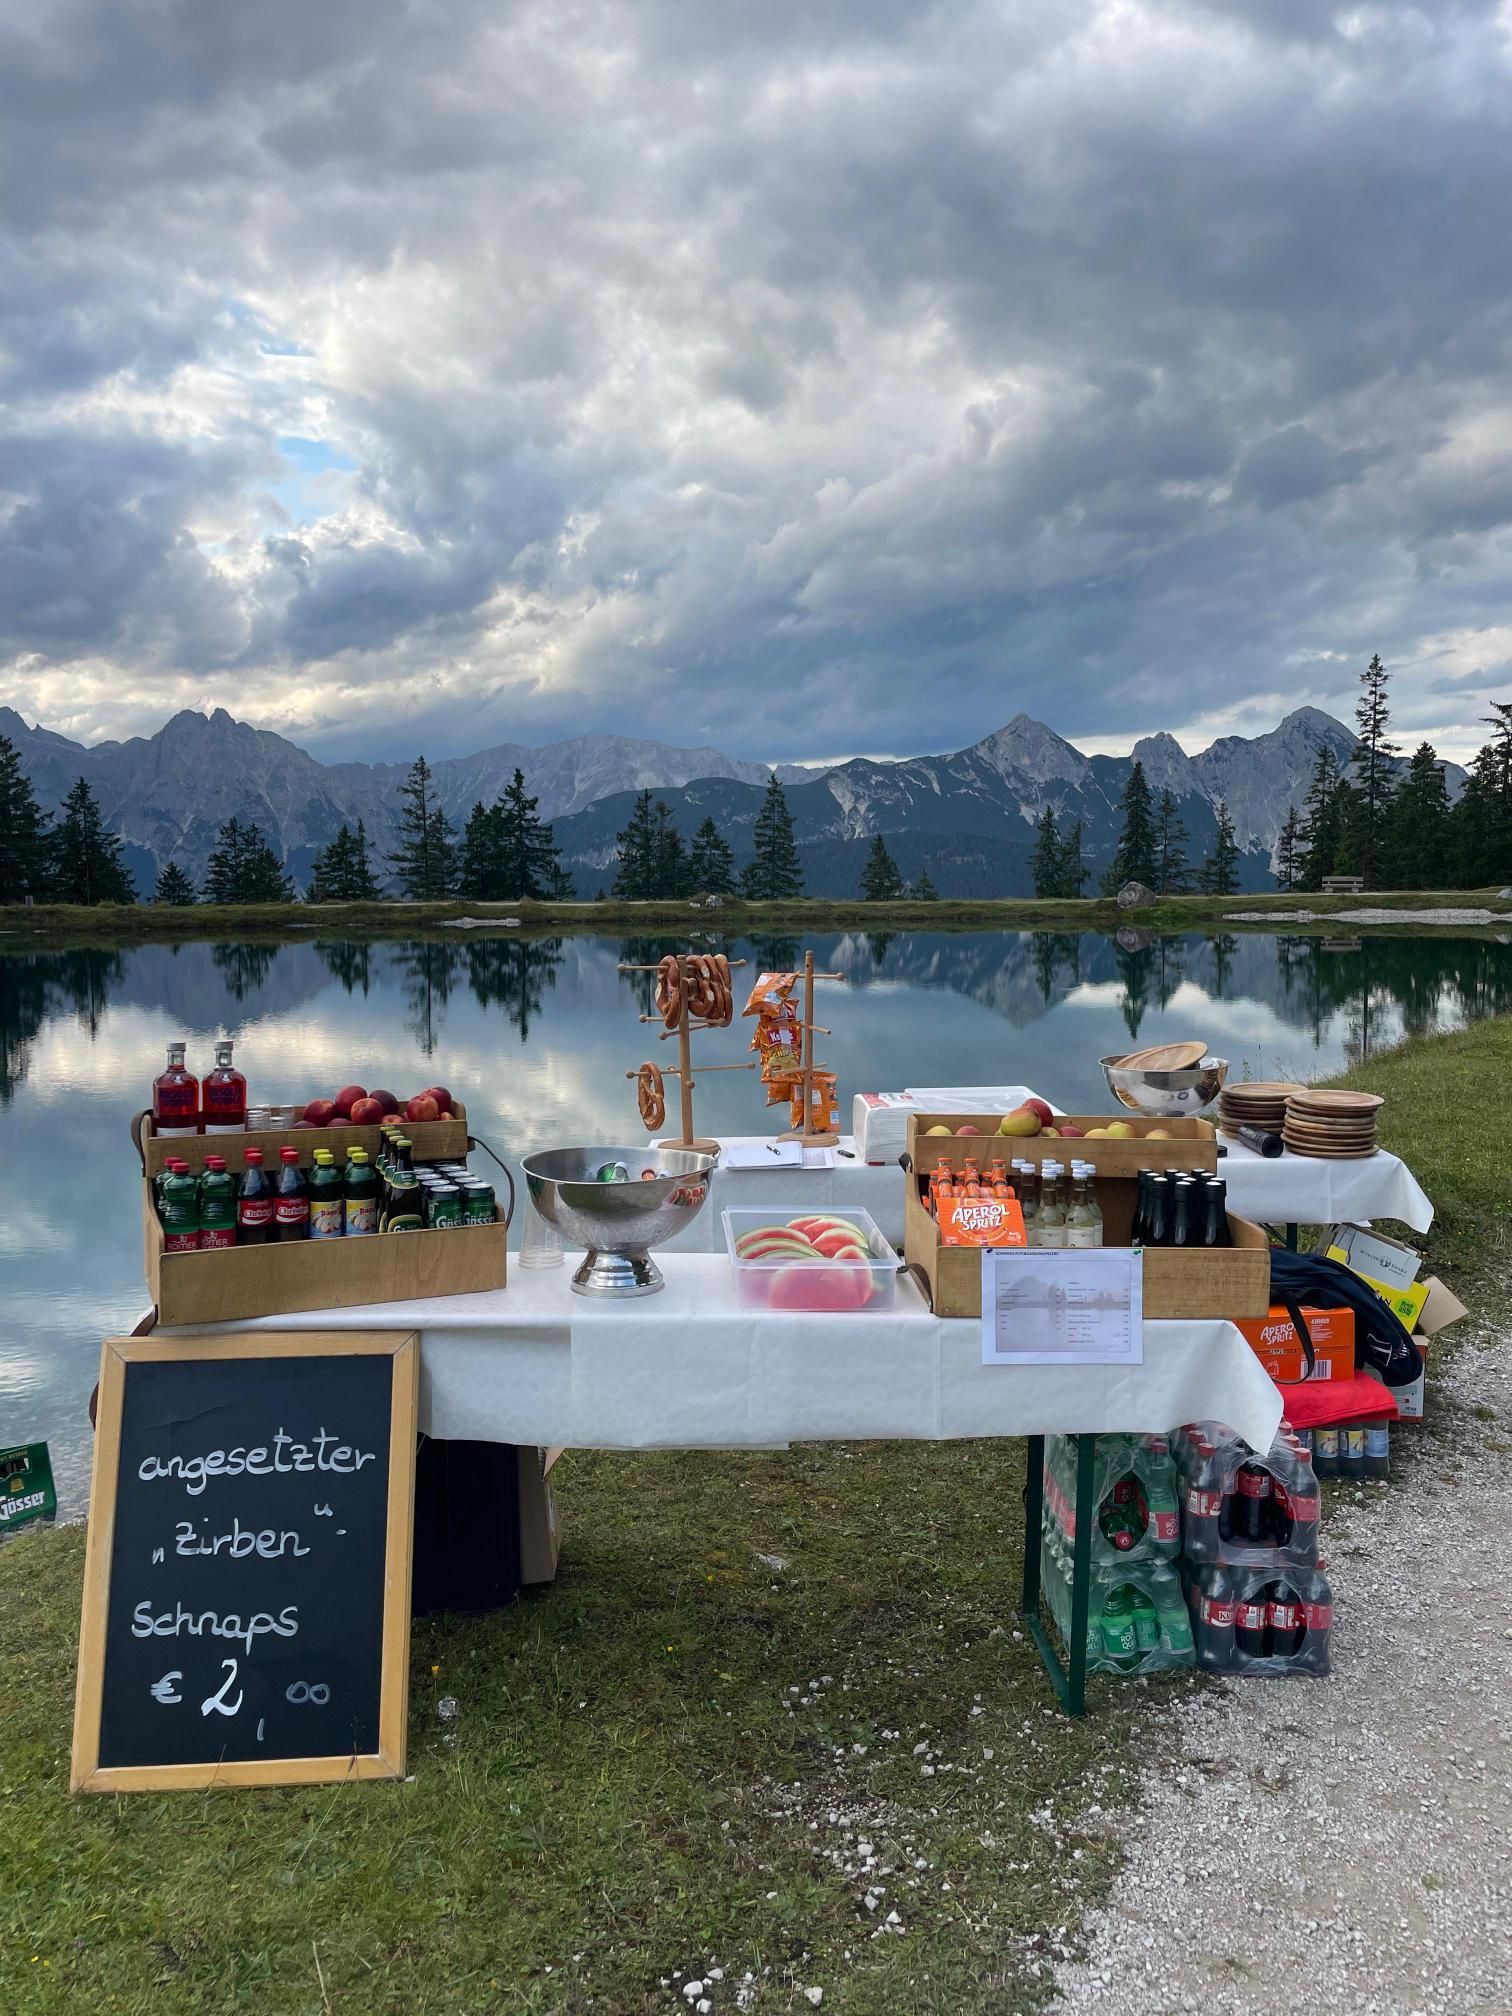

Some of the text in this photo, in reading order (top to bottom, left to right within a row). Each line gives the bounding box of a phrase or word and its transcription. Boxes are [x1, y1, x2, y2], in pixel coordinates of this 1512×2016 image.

[951, 1203, 1010, 1225] APEROL
[962, 1216, 1002, 1231] SPRITZ
[1260, 1322, 1295, 1340] APERO
[1266, 1332, 1293, 1345] SPRITZ
[138, 1427, 376, 1495] angesetzter
[131, 1601, 299, 1656] Schnaps
[150, 1671, 183, 1704] €
